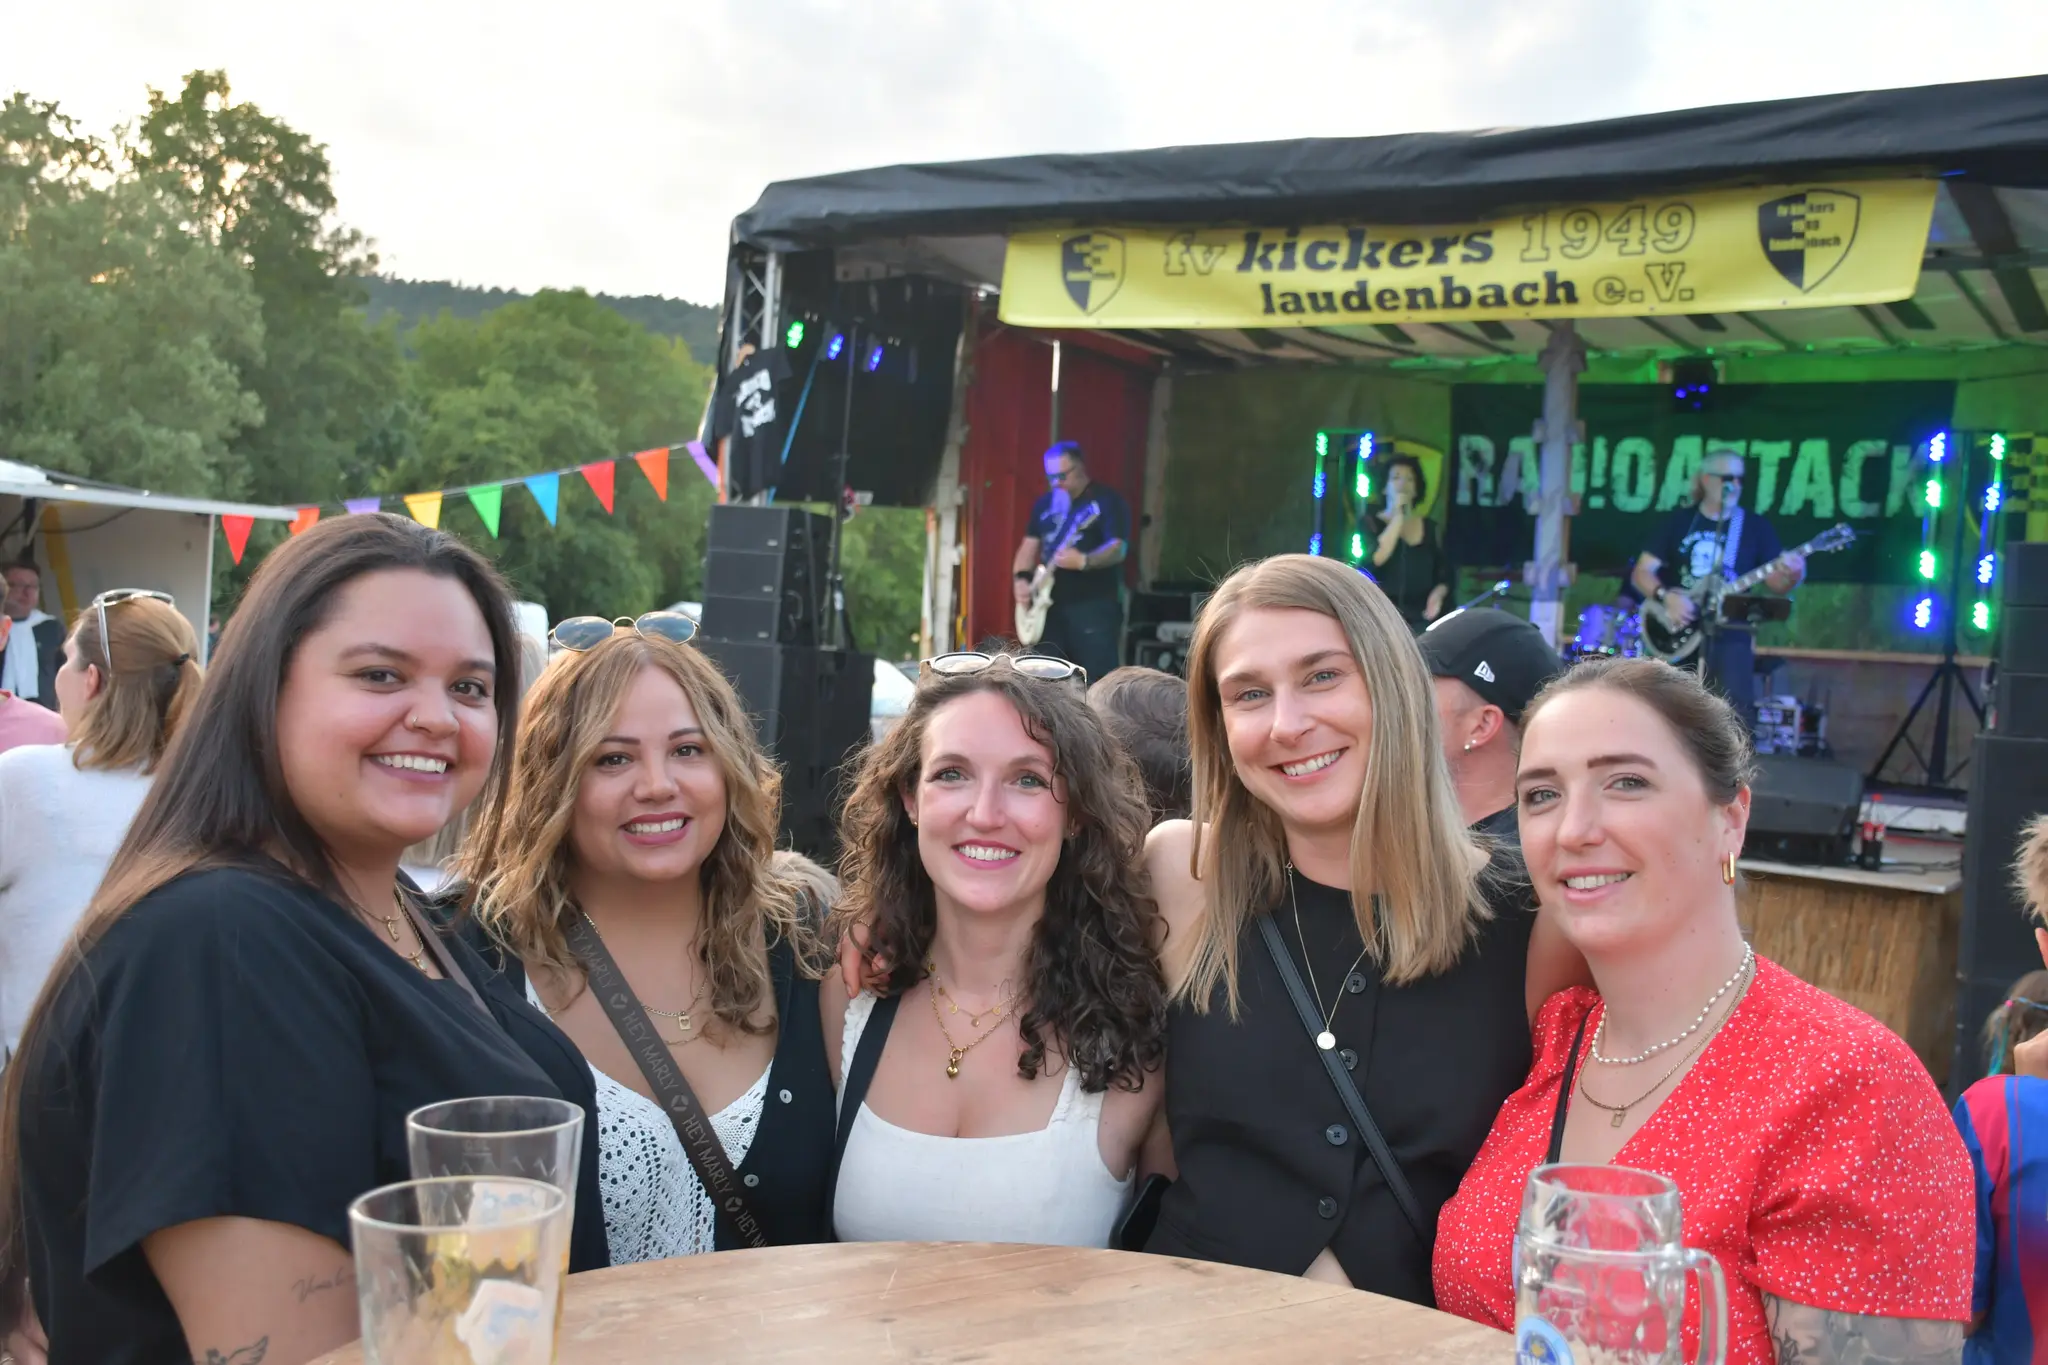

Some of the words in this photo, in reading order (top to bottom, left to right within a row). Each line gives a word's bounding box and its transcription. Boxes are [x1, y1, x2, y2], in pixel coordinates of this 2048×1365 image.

[1164, 228, 1228, 276] fv
[1236, 227, 1494, 274] kickers
[1520, 202, 1696, 262] 1949
[1260, 270, 1578, 315] laudenbach
[1593, 262, 1694, 306] e.V.
[622, 1010, 651, 1042] HEY
[641, 1043, 679, 1090] MARLY
[682, 1112, 710, 1146] HEY
[698, 1146, 733, 1193] MARLY
[735, 1209, 759, 1238] HEY
